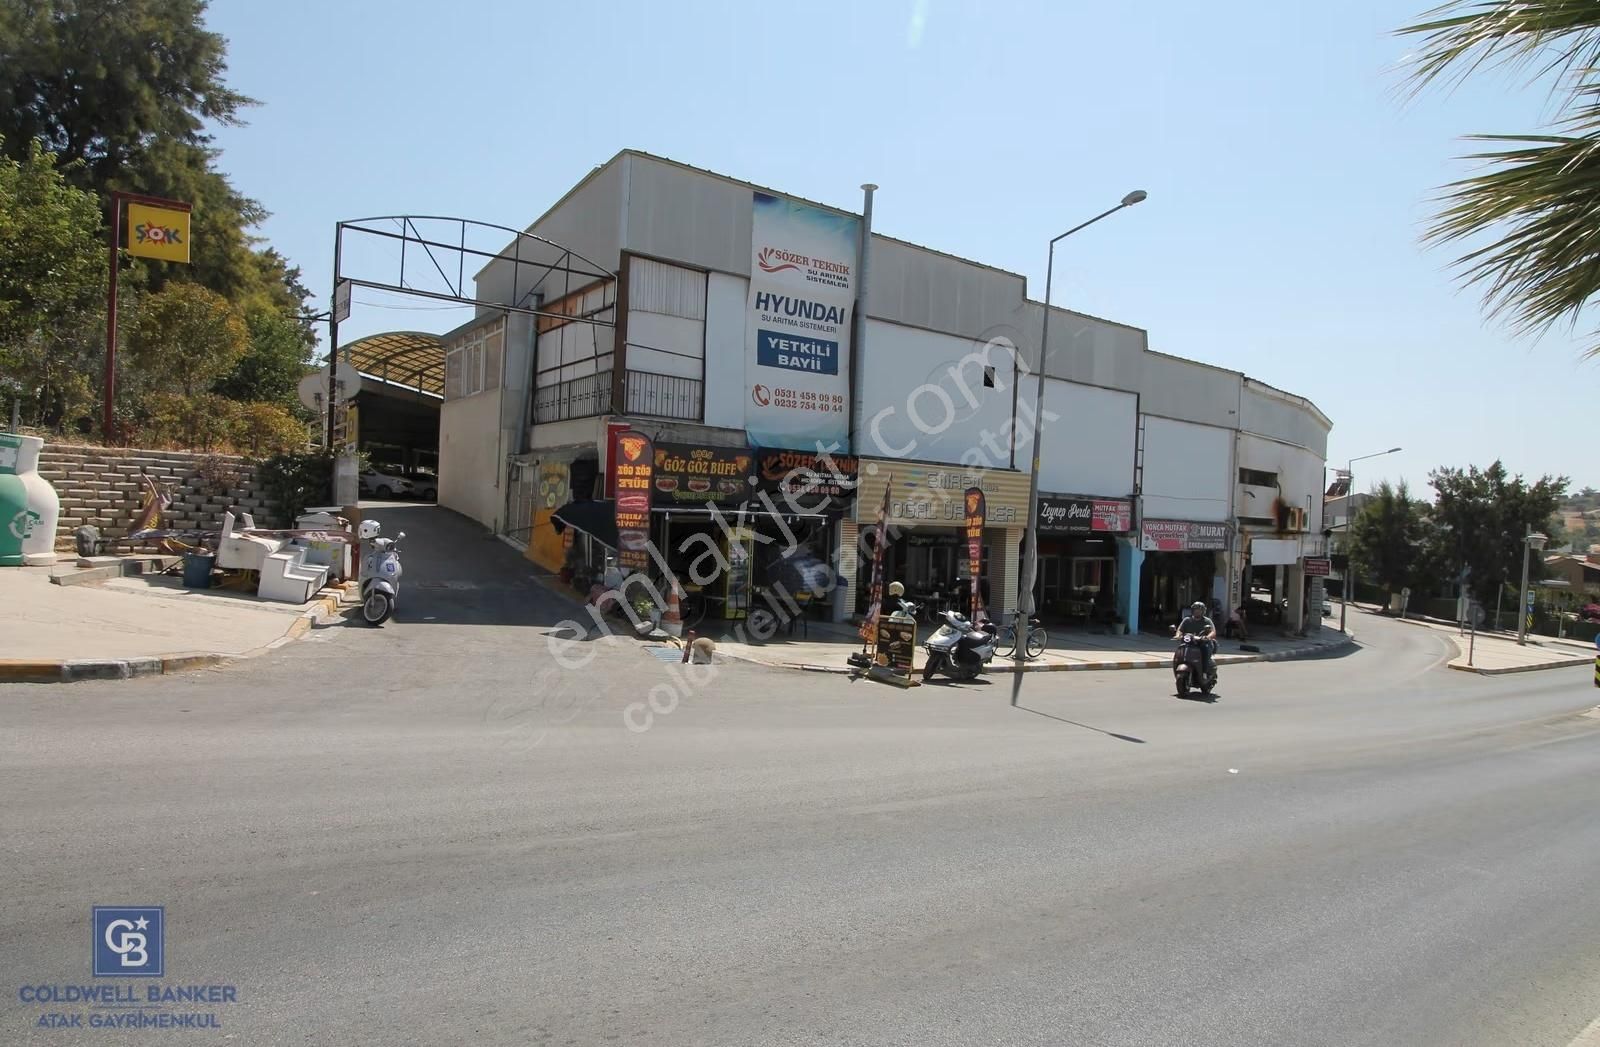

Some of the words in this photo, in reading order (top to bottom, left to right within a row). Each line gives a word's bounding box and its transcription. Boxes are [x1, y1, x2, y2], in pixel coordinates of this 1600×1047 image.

[135, 221, 183, 246] ŞOK
[775, 249, 810, 267] SÖZER
[812, 258, 850, 275] TEKNİK
[820, 272, 848, 282] ARITMA
[755, 291, 845, 325] HYUNDAI
[761, 314, 771, 322] SU
[772, 316, 798, 327] ARITMA
[768, 336, 831, 357] YETKİLİ
[778, 354, 821, 370] BAYİİ
[774, 388, 797, 399] 0531
[799, 391, 817, 401] 458
[818, 393, 829, 402] 09
[832, 395, 843, 404] 80
[774, 398, 798, 409] 0232
[800, 401, 817, 411] 754
[818, 403, 829, 412] 40
[832, 405, 843, 413] 44
[663, 456, 686, 472] GÖZ
[687, 457, 710, 474] GÖZ
[710, 459, 737, 476] BÜFE
[885, 497, 938, 519] OĞAL
[943, 496, 1017, 522] ÜRLER
[1040, 502, 1066, 524] Zeynep
[1067, 503, 1091, 519] Perde
[1200, 526, 1226, 537] MURAT
